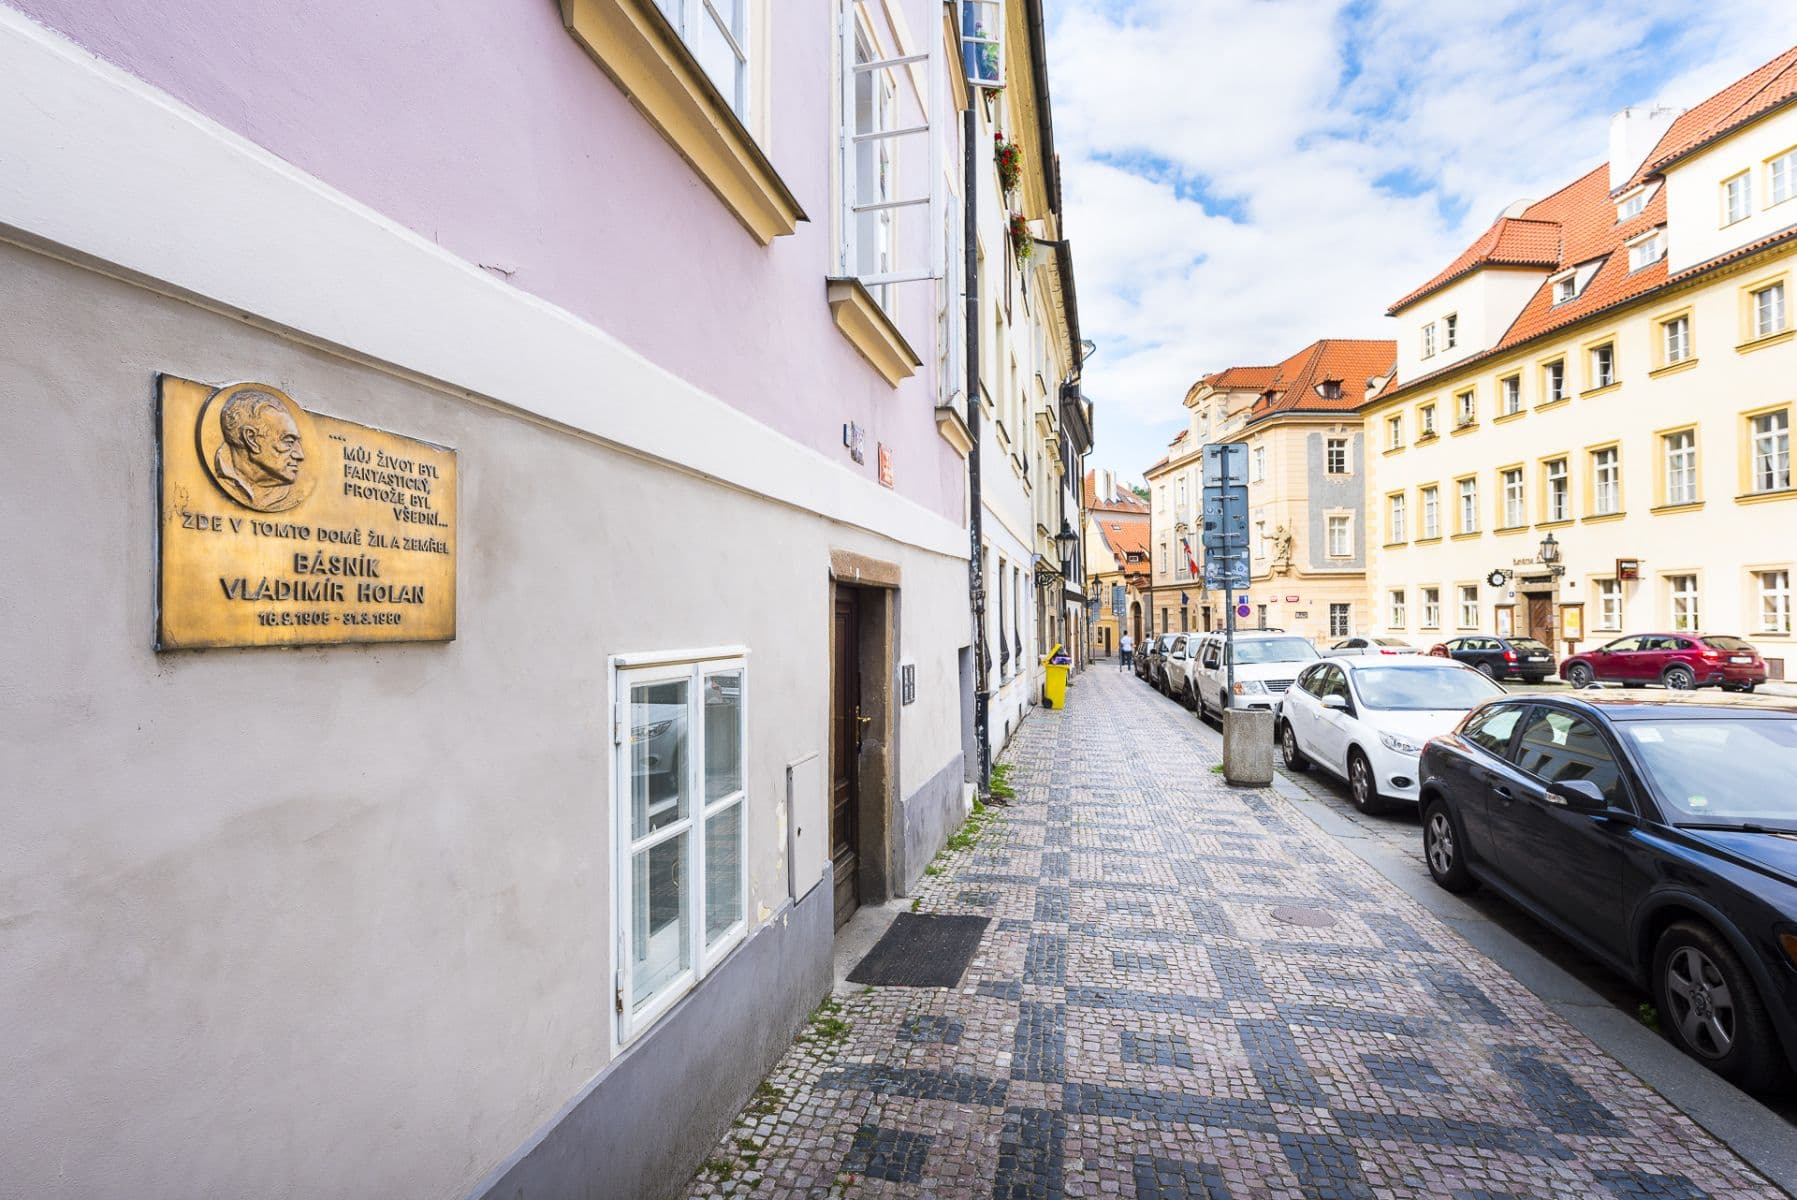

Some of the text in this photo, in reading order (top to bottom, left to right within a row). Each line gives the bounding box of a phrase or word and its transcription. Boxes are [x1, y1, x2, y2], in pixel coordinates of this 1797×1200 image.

[343, 446, 439, 479] MŮJ ŽIVOT BYL
[344, 481, 431, 510] PROTOŽE BYL
[182, 511, 449, 554] ZDE V TOMTO DOMĚ ŽIL A ZEMŘEL
[294, 550, 379, 578] BÁSNÍK
[219, 576, 424, 604] VLADIMÍR HOLAN
